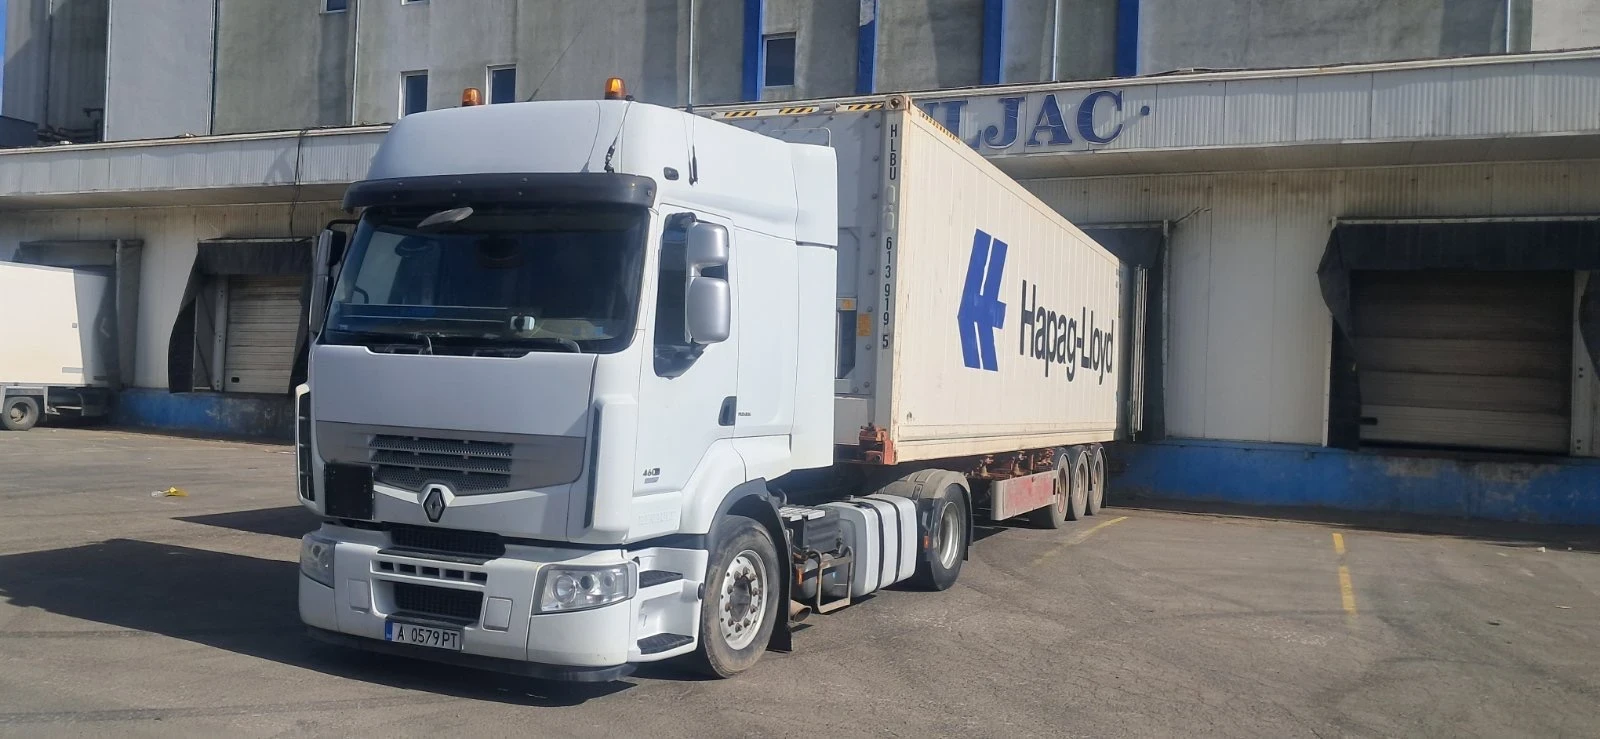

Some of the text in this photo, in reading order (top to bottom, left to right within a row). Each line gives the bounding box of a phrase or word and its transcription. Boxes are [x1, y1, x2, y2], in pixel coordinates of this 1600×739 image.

[923, 91, 1124, 149] LJAC
[889, 124, 898, 181] HLBU
[1020, 279, 1115, 386] Hapag-Lloyd
[398, 625, 405, 641] A
